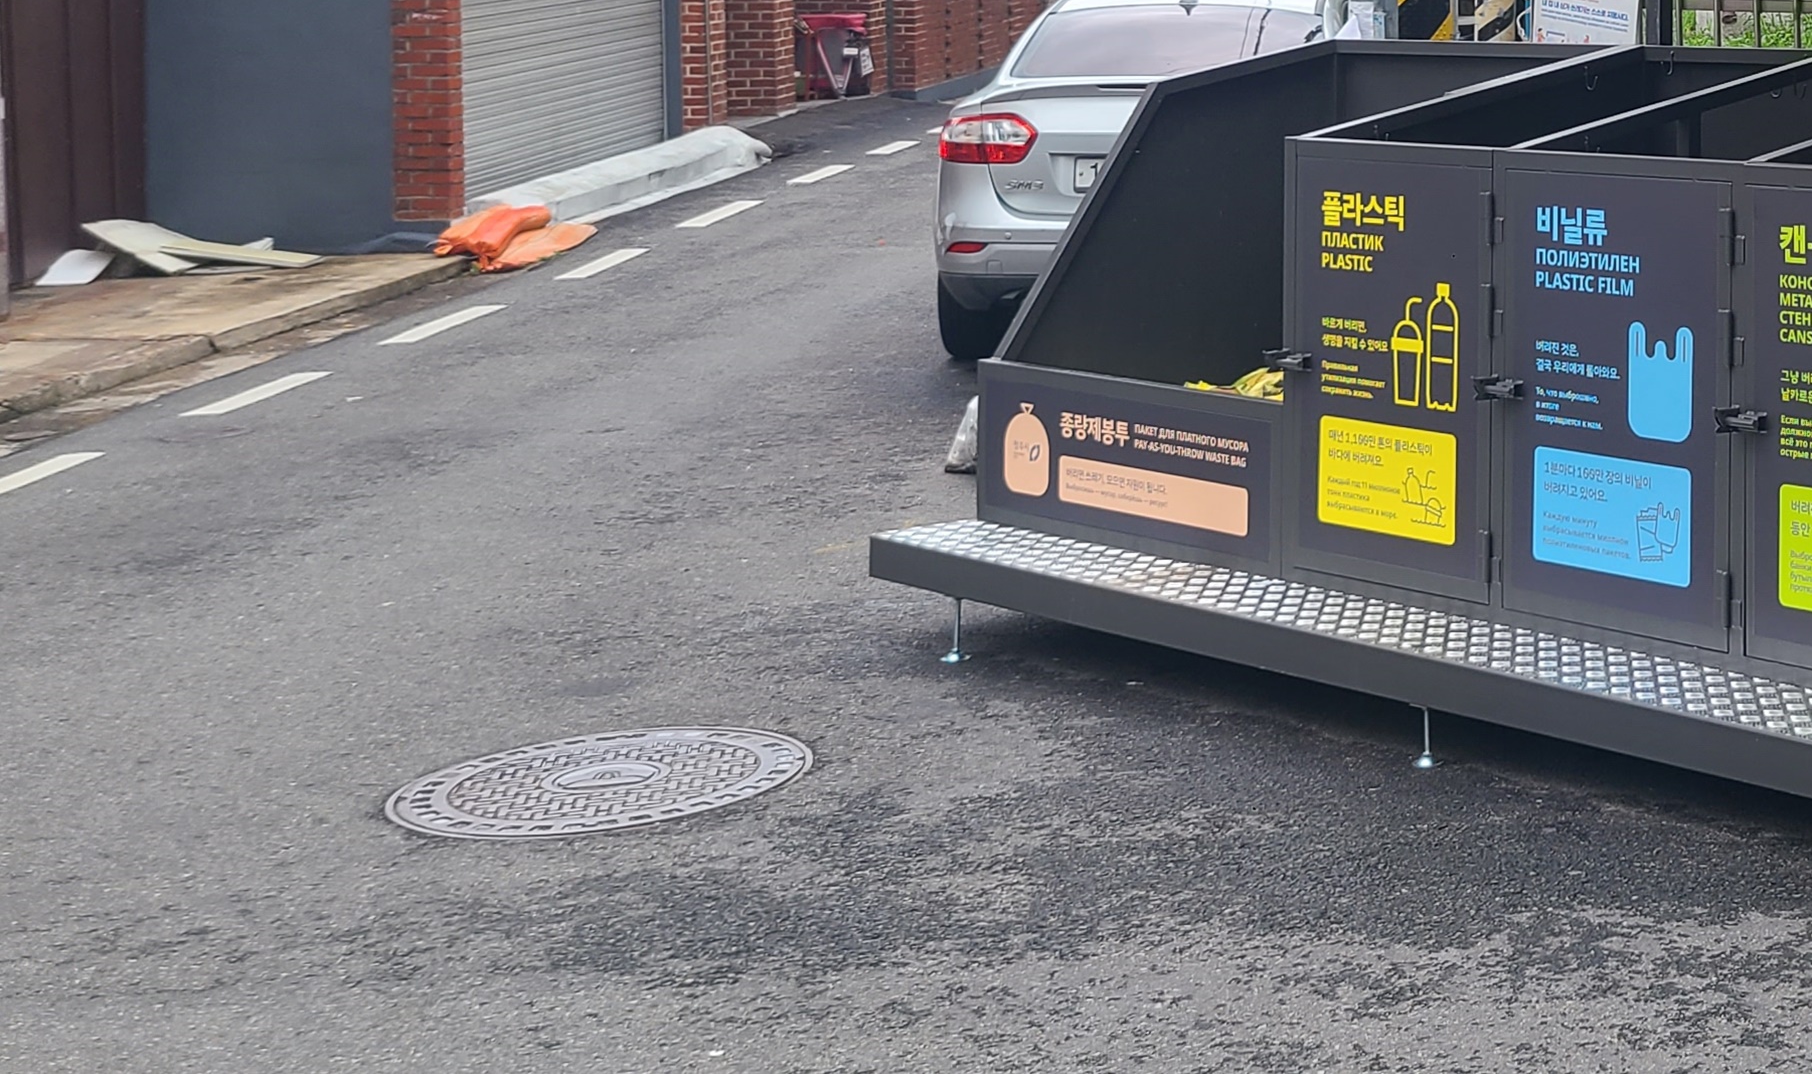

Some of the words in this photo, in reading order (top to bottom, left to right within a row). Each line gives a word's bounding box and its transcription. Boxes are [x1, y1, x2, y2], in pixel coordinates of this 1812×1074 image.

[1321, 191, 1405, 232] 플라스틱
[1536, 206, 1608, 247] 비닐류
[1321, 231, 1384, 252] ПЛАСТИК
[1321, 252, 1373, 272] PLASTIC
[1535, 247, 1640, 274] ПОЛИЭТИЛЕН
[1535, 271, 1594, 292] PLASTIC
[1598, 276, 1633, 296] FILM
[1780, 370, 1799, 384] 그냥
[1060, 412, 1130, 447] 종량제봉투
[1780, 415, 1799, 425] Если
[1134, 423, 1158, 436] ПАКЕТ
[1157, 427, 1174, 439] ДЛЯ
[1176, 430, 1216, 446] ПЛАТНОГО
[1216, 438, 1249, 452] МУСОРА
[1780, 437, 1794, 446] всё
[1796, 440, 1808, 448] это
[1204, 451, 1229, 464] WASTE
[1230, 455, 1246, 467] BAG
[1780, 448, 1809, 459] острые
